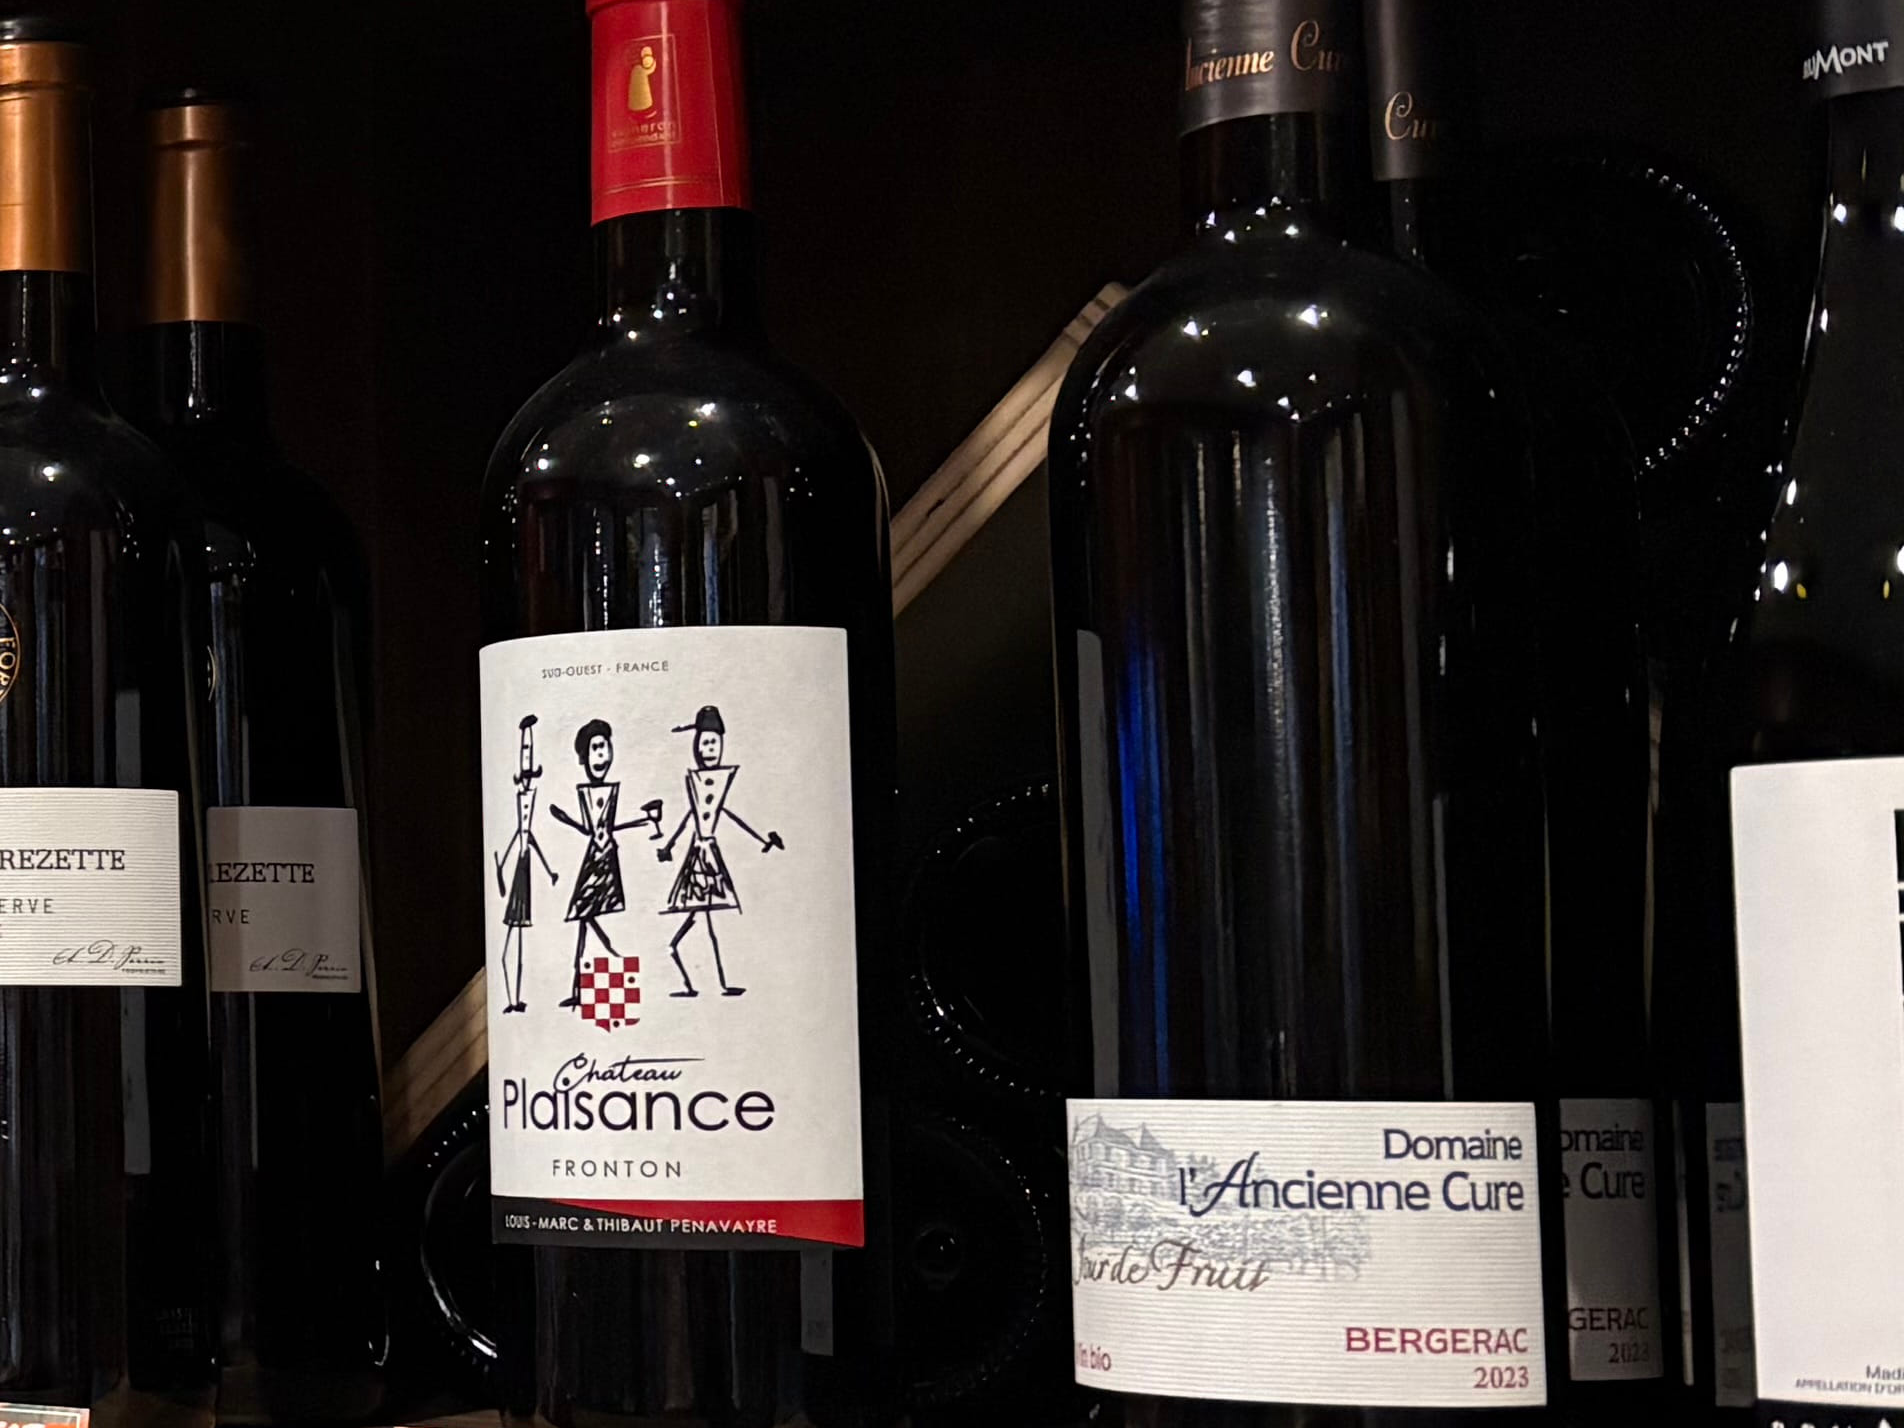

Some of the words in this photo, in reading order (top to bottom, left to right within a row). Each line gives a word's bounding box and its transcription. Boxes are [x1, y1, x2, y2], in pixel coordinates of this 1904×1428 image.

[503, 1078, 776, 1132] Plaisance
[1384, 1128, 1522, 1160] Domaine
[552, 1159, 682, 1179] FRONTON
[1442, 1170, 1525, 1211] Cure
[1345, 1327, 1528, 1355] BERGERAC
[1473, 1366, 1529, 1390] 2023
